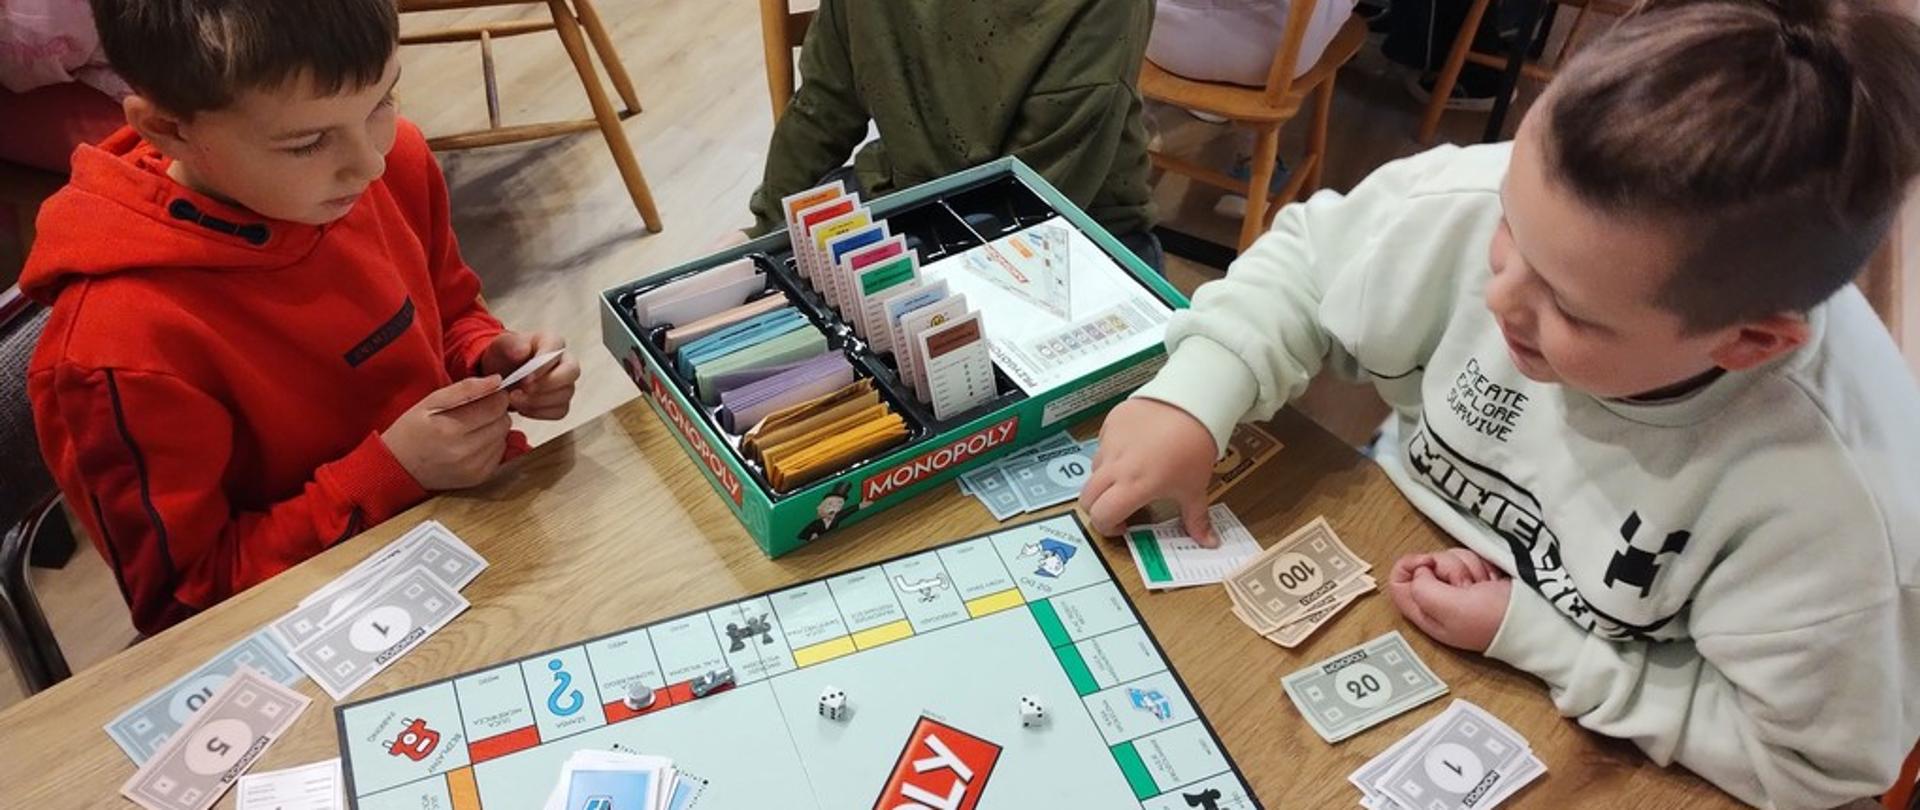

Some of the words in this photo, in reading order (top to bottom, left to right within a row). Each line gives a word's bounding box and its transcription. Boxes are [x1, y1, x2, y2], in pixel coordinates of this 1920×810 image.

[1456, 372, 1521, 426] EXPLORE
[1466, 357, 1529, 411] CREATE
[1447, 388, 1512, 442] SURVIVE
[651, 380, 740, 496] MONOPOLY
[868, 419, 1016, 498] MONOPOLY
[1058, 461, 1085, 481] 10
[1279, 560, 1315, 589] 100
[370, 620, 390, 636] 1
[1346, 673, 1381, 699] 20
[206, 737, 231, 756] 5
[892, 733, 974, 810] LY
[1442, 759, 1463, 777] 1
